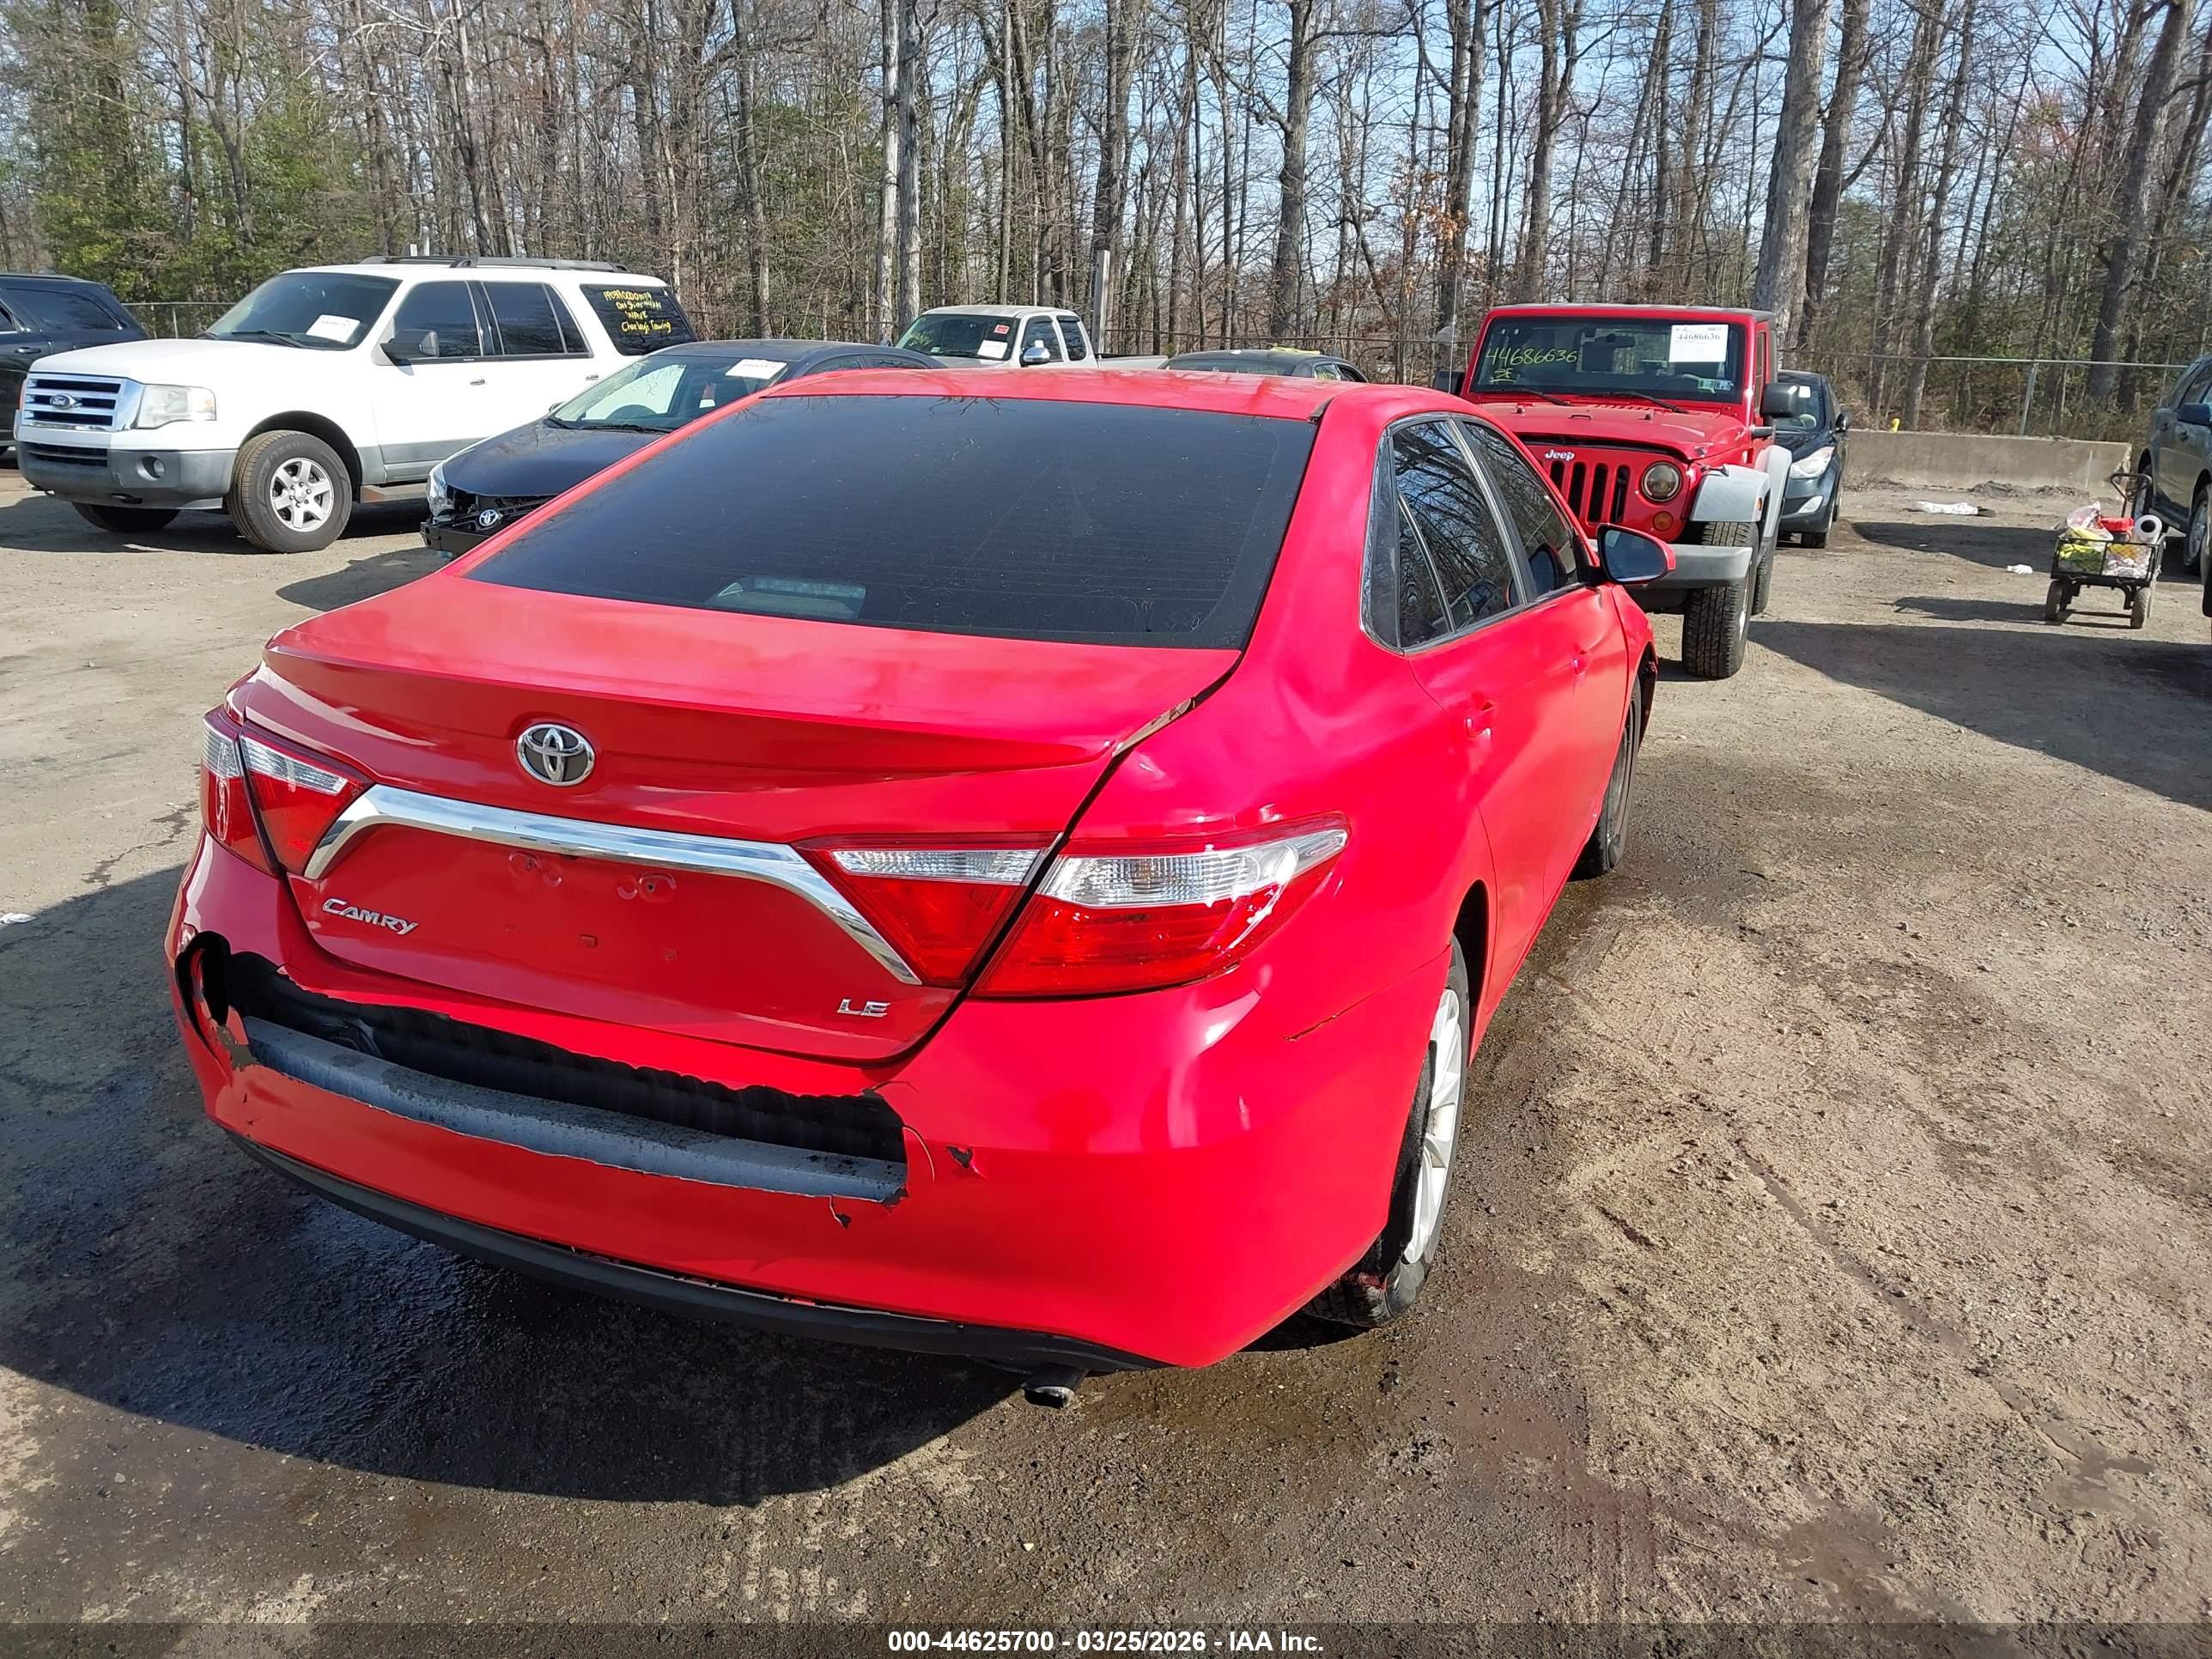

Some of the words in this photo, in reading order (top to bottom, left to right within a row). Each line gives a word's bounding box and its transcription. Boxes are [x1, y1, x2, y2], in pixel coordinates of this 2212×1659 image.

[1677, 332, 1721, 341] 44686636
[1486, 347, 1578, 368] 44686636
[1545, 449, 1576, 462] Jeep
[322, 898, 420, 936] CAMRY
[836, 998, 892, 1018] LE
